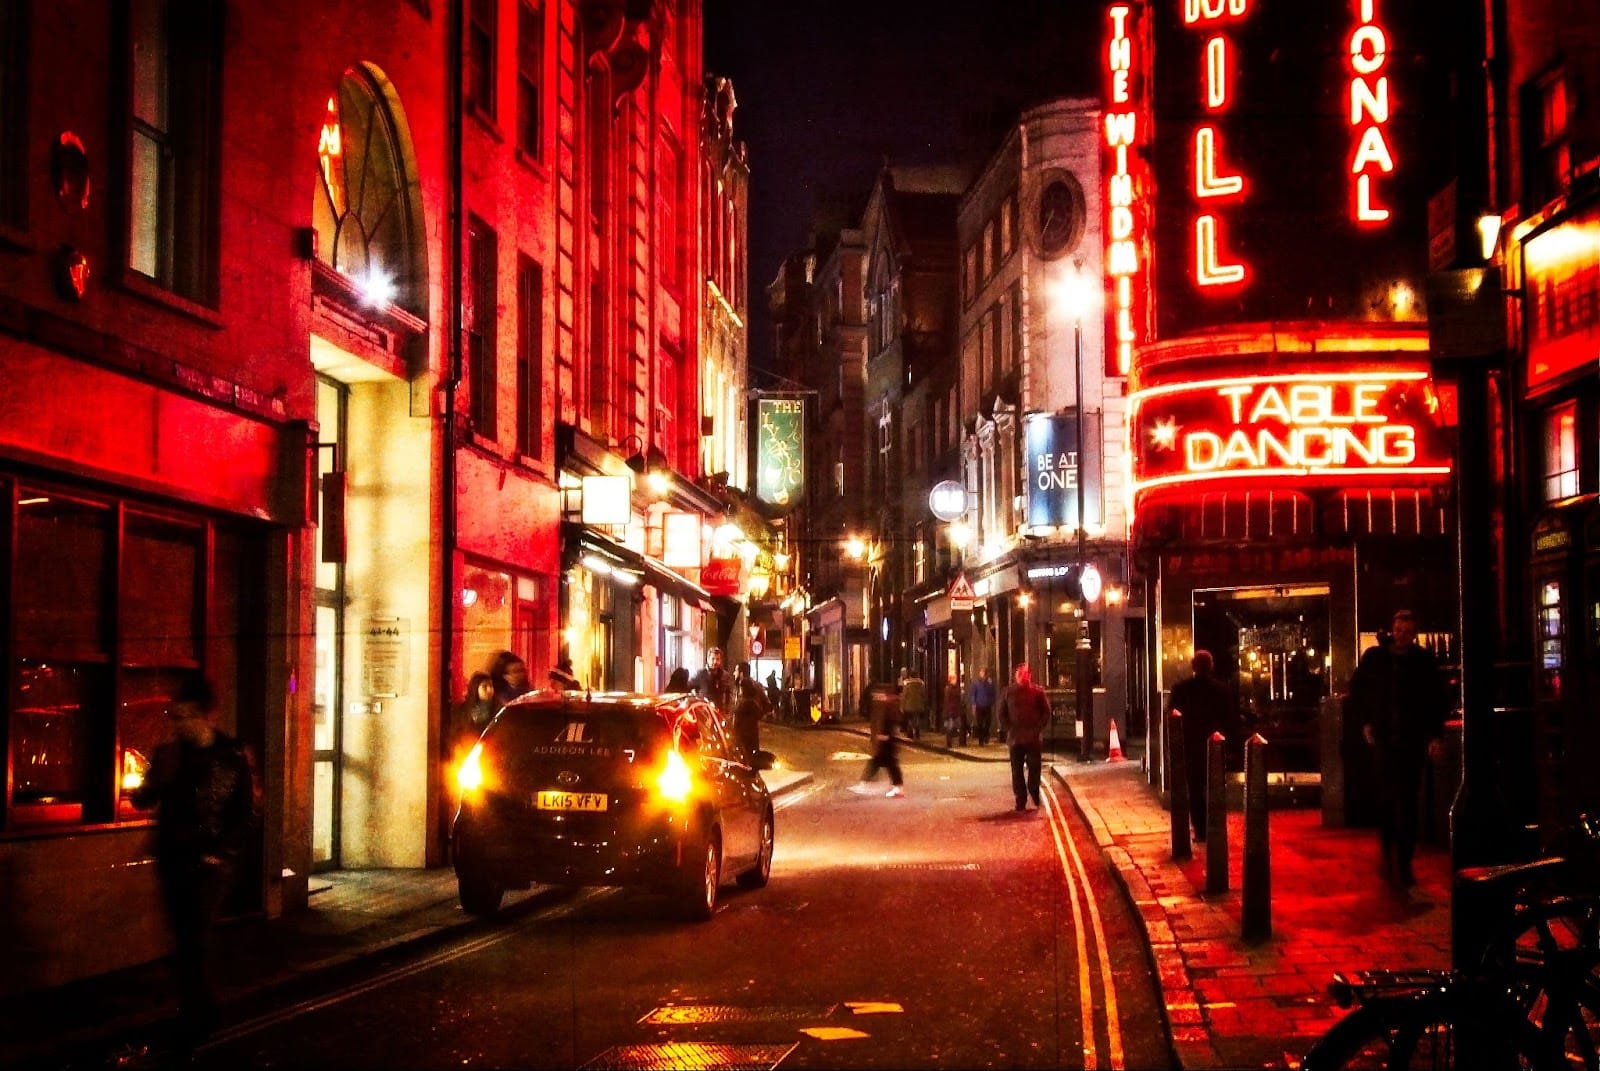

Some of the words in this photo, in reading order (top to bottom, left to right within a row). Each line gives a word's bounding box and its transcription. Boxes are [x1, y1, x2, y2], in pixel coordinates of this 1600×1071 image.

[1109, 6, 1131, 103] THE
[773, 401, 801, 413] THE
[1217, 384, 1388, 424] TABLE
[1185, 425, 1416, 471] DANCING
[1037, 453, 1054, 471] BE
[1058, 451, 1078, 467] AT
[1038, 469, 1078, 490] ONE
[533, 746, 585, 756] ADDISON
[543, 793, 573, 808] LK15
[577, 794, 603, 809] VFV
